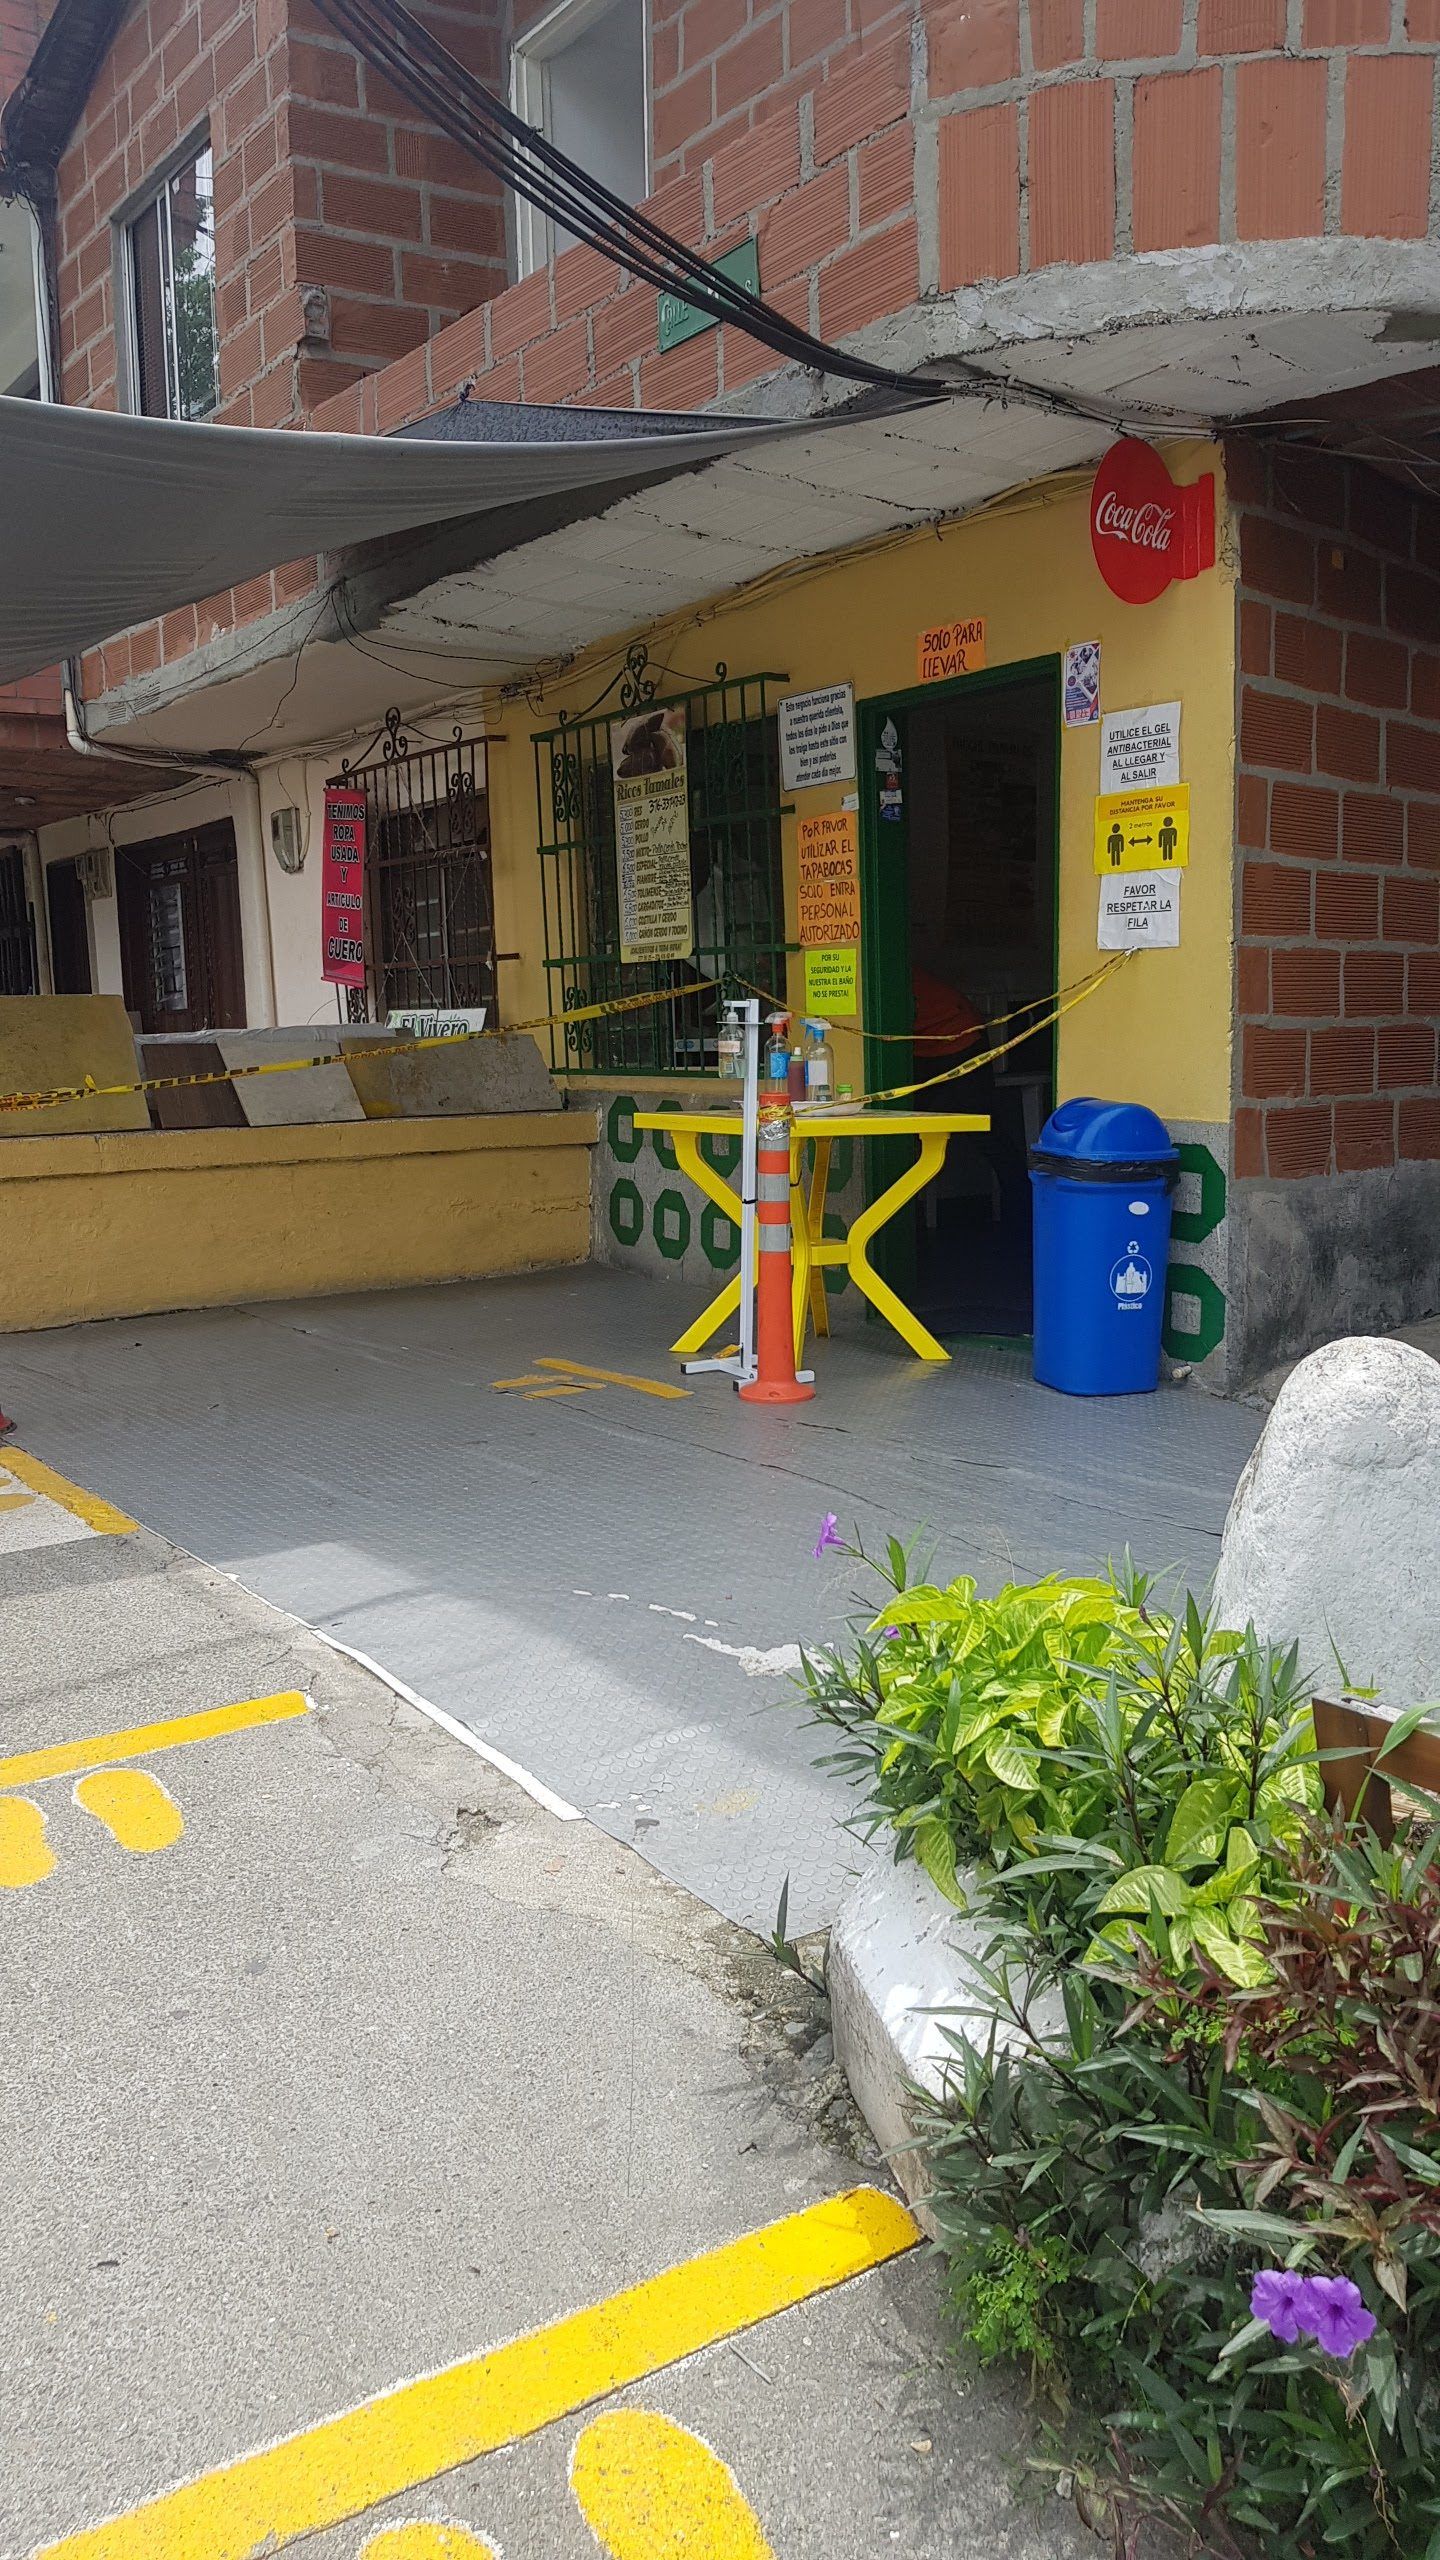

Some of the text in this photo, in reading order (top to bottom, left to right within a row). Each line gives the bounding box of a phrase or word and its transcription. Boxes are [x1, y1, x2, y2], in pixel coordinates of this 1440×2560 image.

[1096, 491, 1176, 551] Coca-Cola
[923, 621, 983, 653] SOLO PARA
[923, 649, 968, 678] LLEVAR
[785, 690, 846, 712] Este negocio funciona gracias
[793, 713, 809, 725] nuestra
[809, 709, 824, 724] querida
[818, 723, 828, 736] pido
[831, 720, 841, 731] Dios
[841, 720, 849, 731] que
[1109, 722, 1171, 741] UTILICE EL GEL
[796, 743, 808, 755] traiga
[808, 740, 820, 751] hasta
[820, 738, 829, 749] este
[829, 735, 839, 746] sitio
[839, 735, 847, 744] con
[1107, 736, 1172, 756] ANTIBACTERIAL
[819, 752, 837, 766] poderlos
[1112, 752, 1166, 768] AL LLEGAR Y
[811, 769, 821, 780] cada
[1121, 767, 1157, 781] AL SALIR
[643, 773, 685, 795] Tamales
[1109, 801, 1176, 816] DISTANCIA POR FAVOR
[1120, 796, 1153, 807] MANTENGA
[327, 801, 366, 821] TEÑIMOS
[333, 824, 355, 841] ROPA
[822, 818, 848, 835] FAVOR
[331, 845, 360, 863] USADA
[801, 839, 854, 859] UTILIZAR EL
[340, 866, 348, 883] Y
[800, 859, 853, 880] TAPABOCAS
[800, 881, 856, 899] SOLO ENTRA
[1124, 884, 1156, 896] FAVOR
[801, 902, 854, 920] PERSONAL
[1106, 899, 1172, 913] RESPETAR LA
[339, 916, 349, 933] DE
[1127, 917, 1149, 928] FILA
[800, 921, 860, 942] AUTORIZADO
[328, 936, 363, 963] CUERO
[822, 953, 840, 962] POR SU
[810, 966, 840, 974] SEGURIDAD
[845, 965, 852, 973] LA
[808, 975, 854, 987] NUESTRA EL BAÑO
[812, 990, 821, 998] NO
[821, 990, 828, 998] SE
[419, 1015, 469, 1038] Vivero
